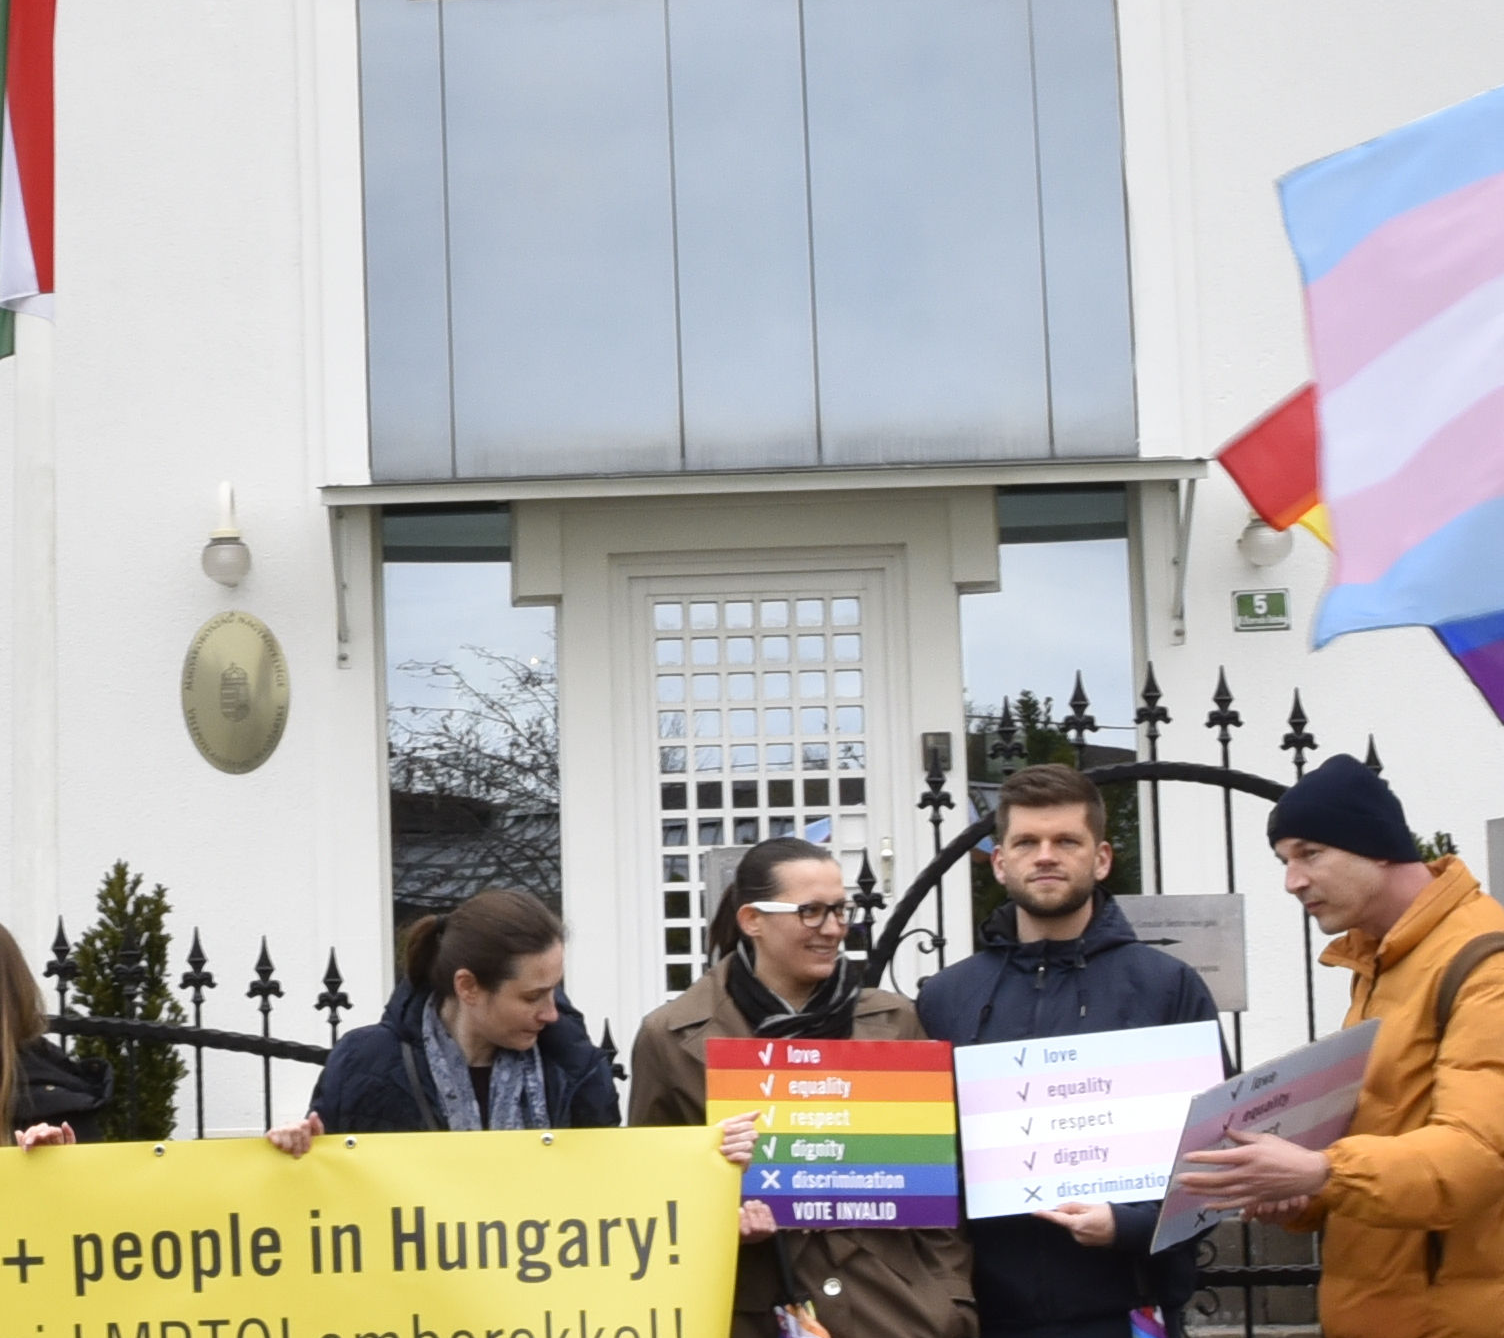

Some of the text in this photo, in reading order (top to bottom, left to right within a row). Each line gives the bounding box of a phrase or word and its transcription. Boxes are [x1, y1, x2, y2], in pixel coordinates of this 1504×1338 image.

[1253, 594, 1268, 614] 5
[786, 1045, 821, 1063] love
[1043, 1048, 1078, 1064] love
[788, 1076, 852, 1098] equality
[1047, 1077, 1113, 1098] equality
[1250, 1071, 1277, 1092] love
[1242, 1092, 1290, 1123] equality
[790, 1110, 851, 1129] respect
[1050, 1111, 1114, 1131] respect
[790, 1139, 845, 1161] dignity
[1053, 1145, 1110, 1166] dignity
[791, 1171, 905, 1190] discrimination
[1057, 1172, 1171, 1198] discriminatio
[792, 1201, 897, 1221] VOTE INVALID
[73, 1212, 282, 1297] people
[311, 1210, 362, 1275] in
[391, 1200, 683, 1283] Hungary!
